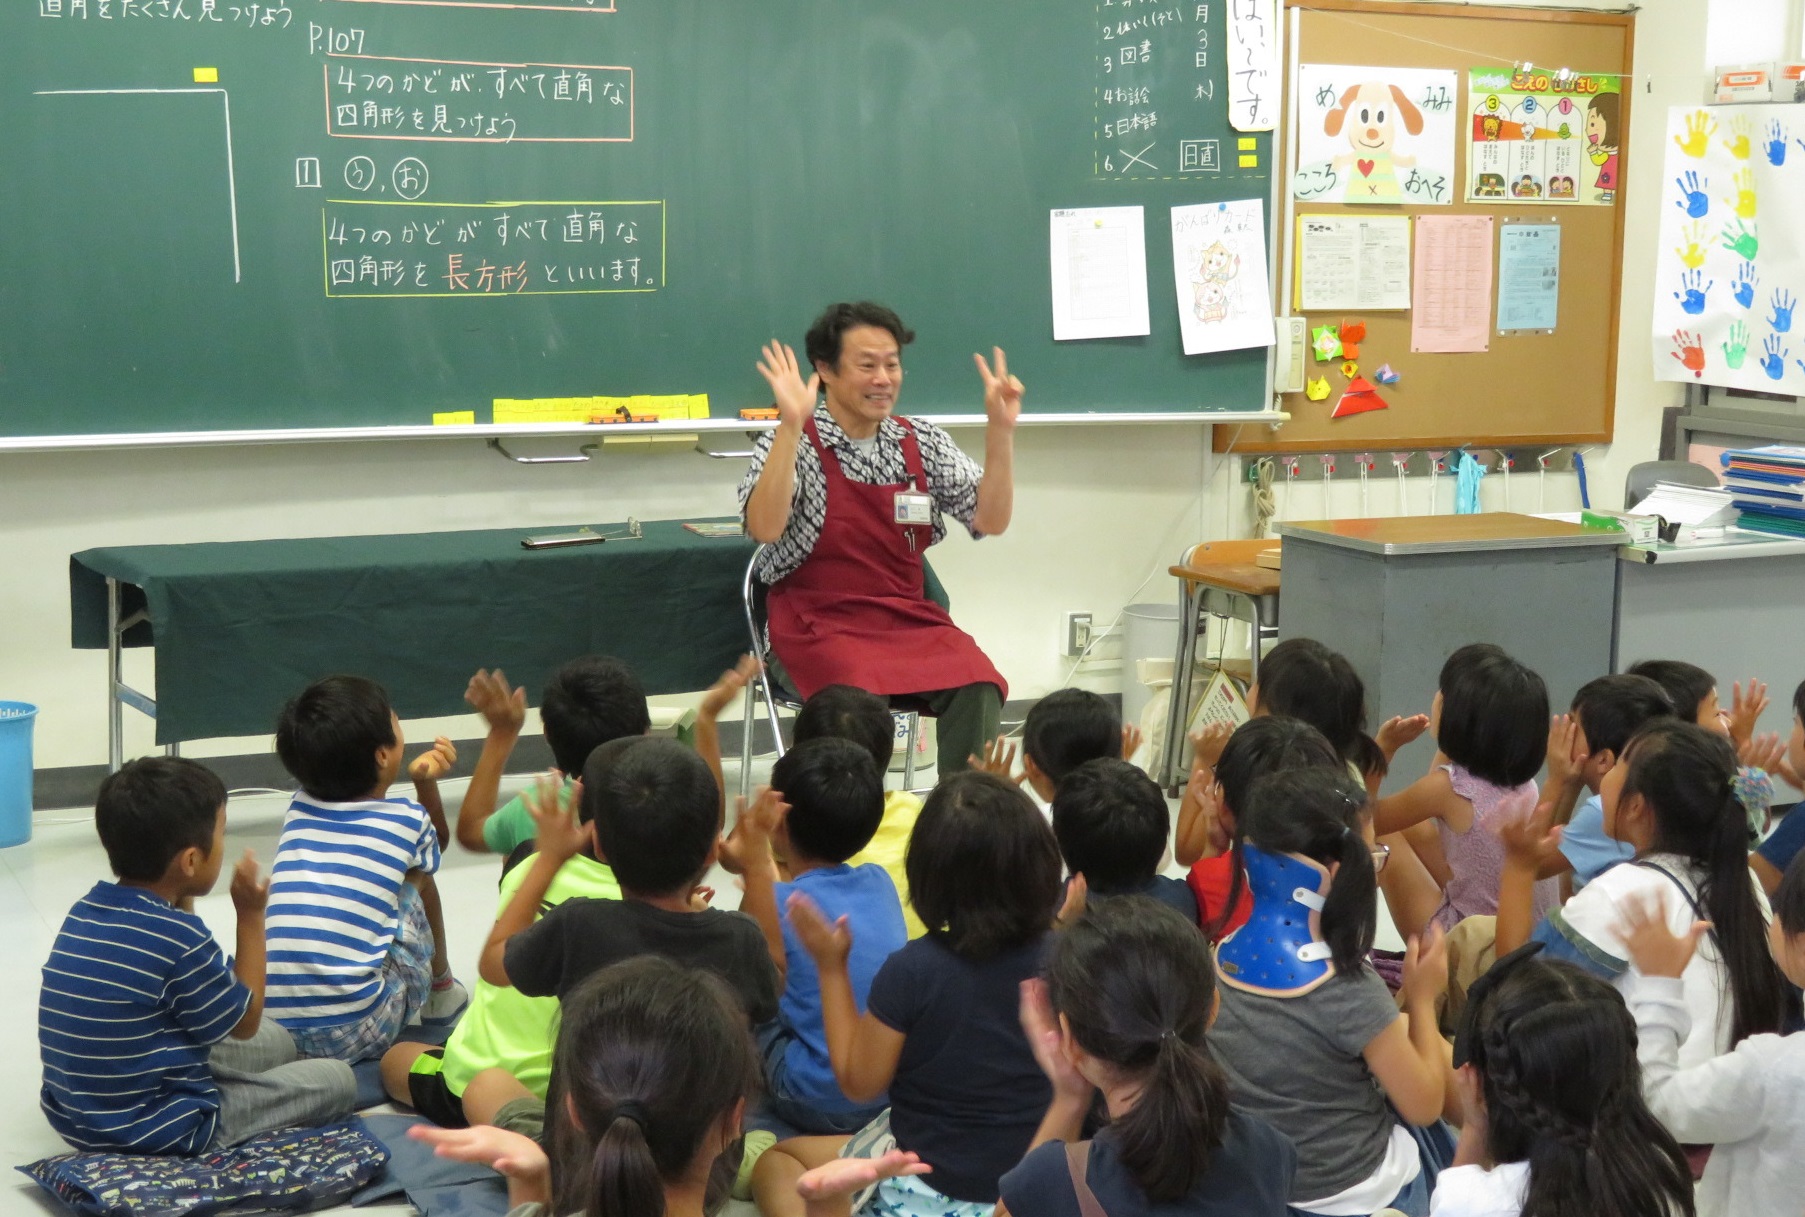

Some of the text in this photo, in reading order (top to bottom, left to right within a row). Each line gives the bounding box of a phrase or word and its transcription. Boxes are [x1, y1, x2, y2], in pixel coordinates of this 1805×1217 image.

[1315, 83, 1336, 107] め
[1422, 86, 1452, 111] みみ
[1298, 163, 1337, 195] こころ
[1404, 168, 1446, 202] おへそ
